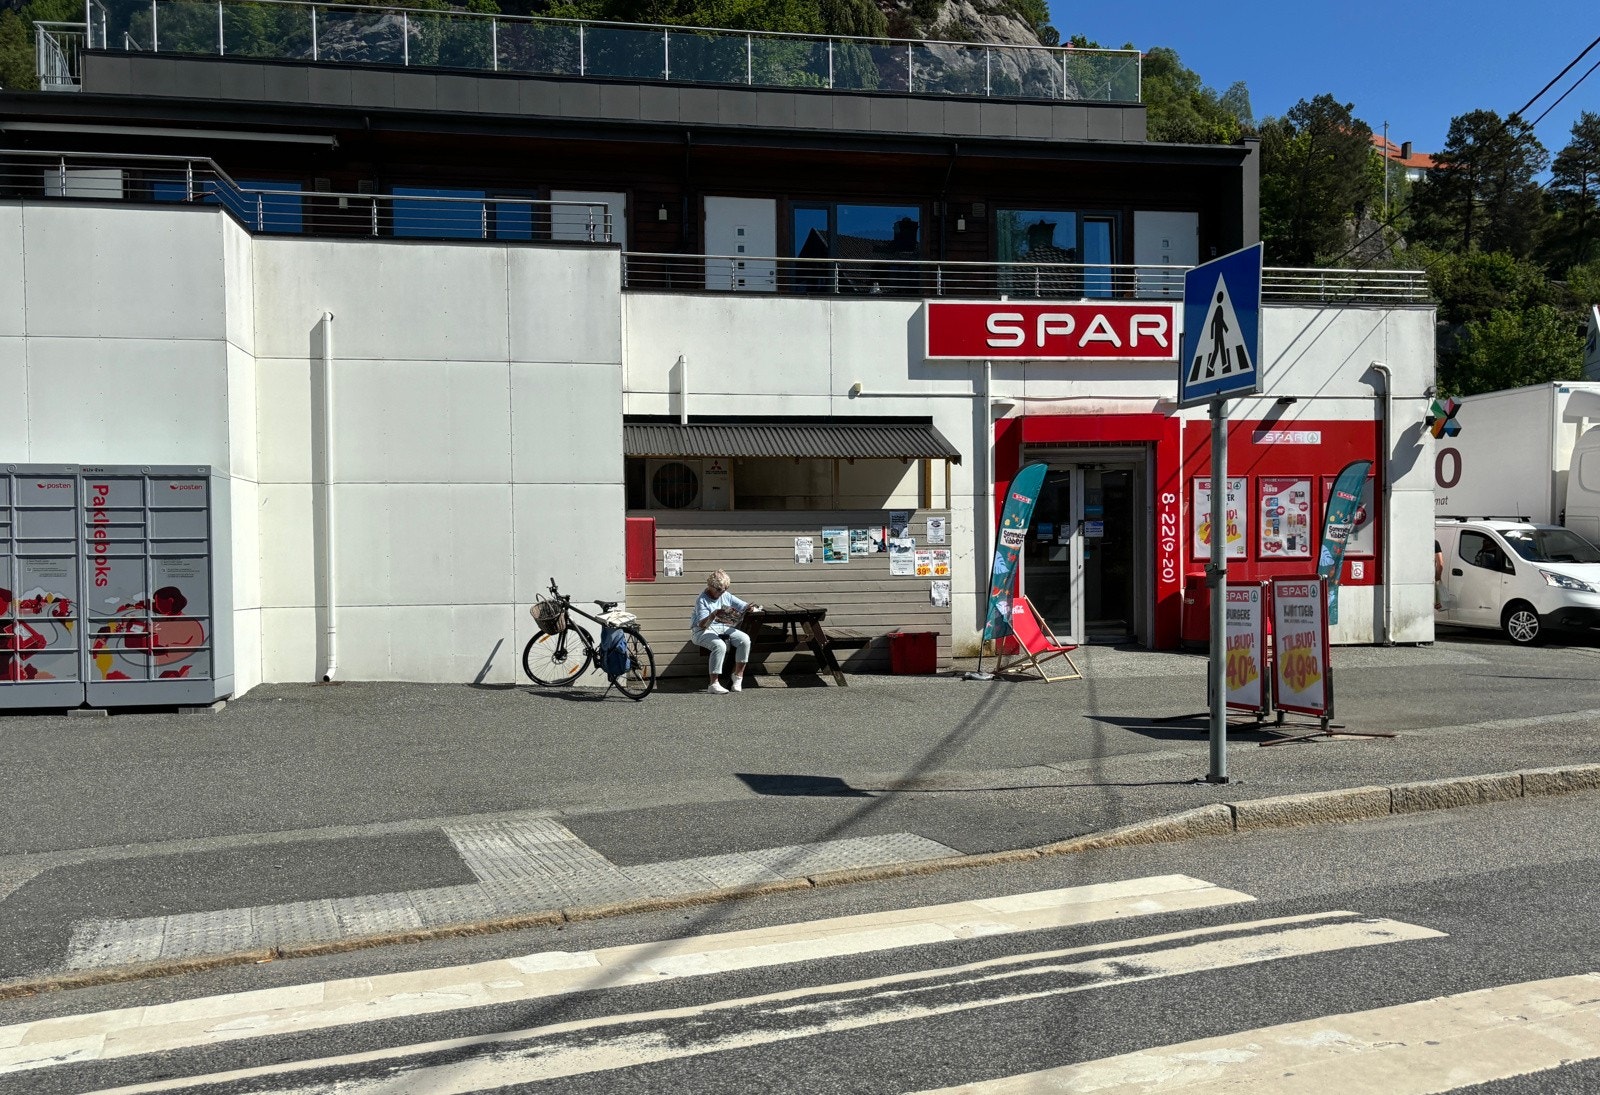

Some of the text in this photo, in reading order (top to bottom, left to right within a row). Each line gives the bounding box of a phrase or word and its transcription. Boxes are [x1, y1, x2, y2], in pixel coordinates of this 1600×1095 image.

[986, 312, 1169, 348] SPAR
[1265, 432, 1304, 442] SPAR
[179, 483, 203, 491] posten
[92, 484, 111, 587] Pakkeboks
[1003, 529, 1025, 539] Sommer
[1161, 492, 1176, 583] 8-22(9-20)
[1281, 586, 1308, 596] SPAR
[1226, 632, 1255, 652] ILBUD!
[1282, 630, 1316, 651] TILBUD!
[1226, 654, 1256, 687] 40%
